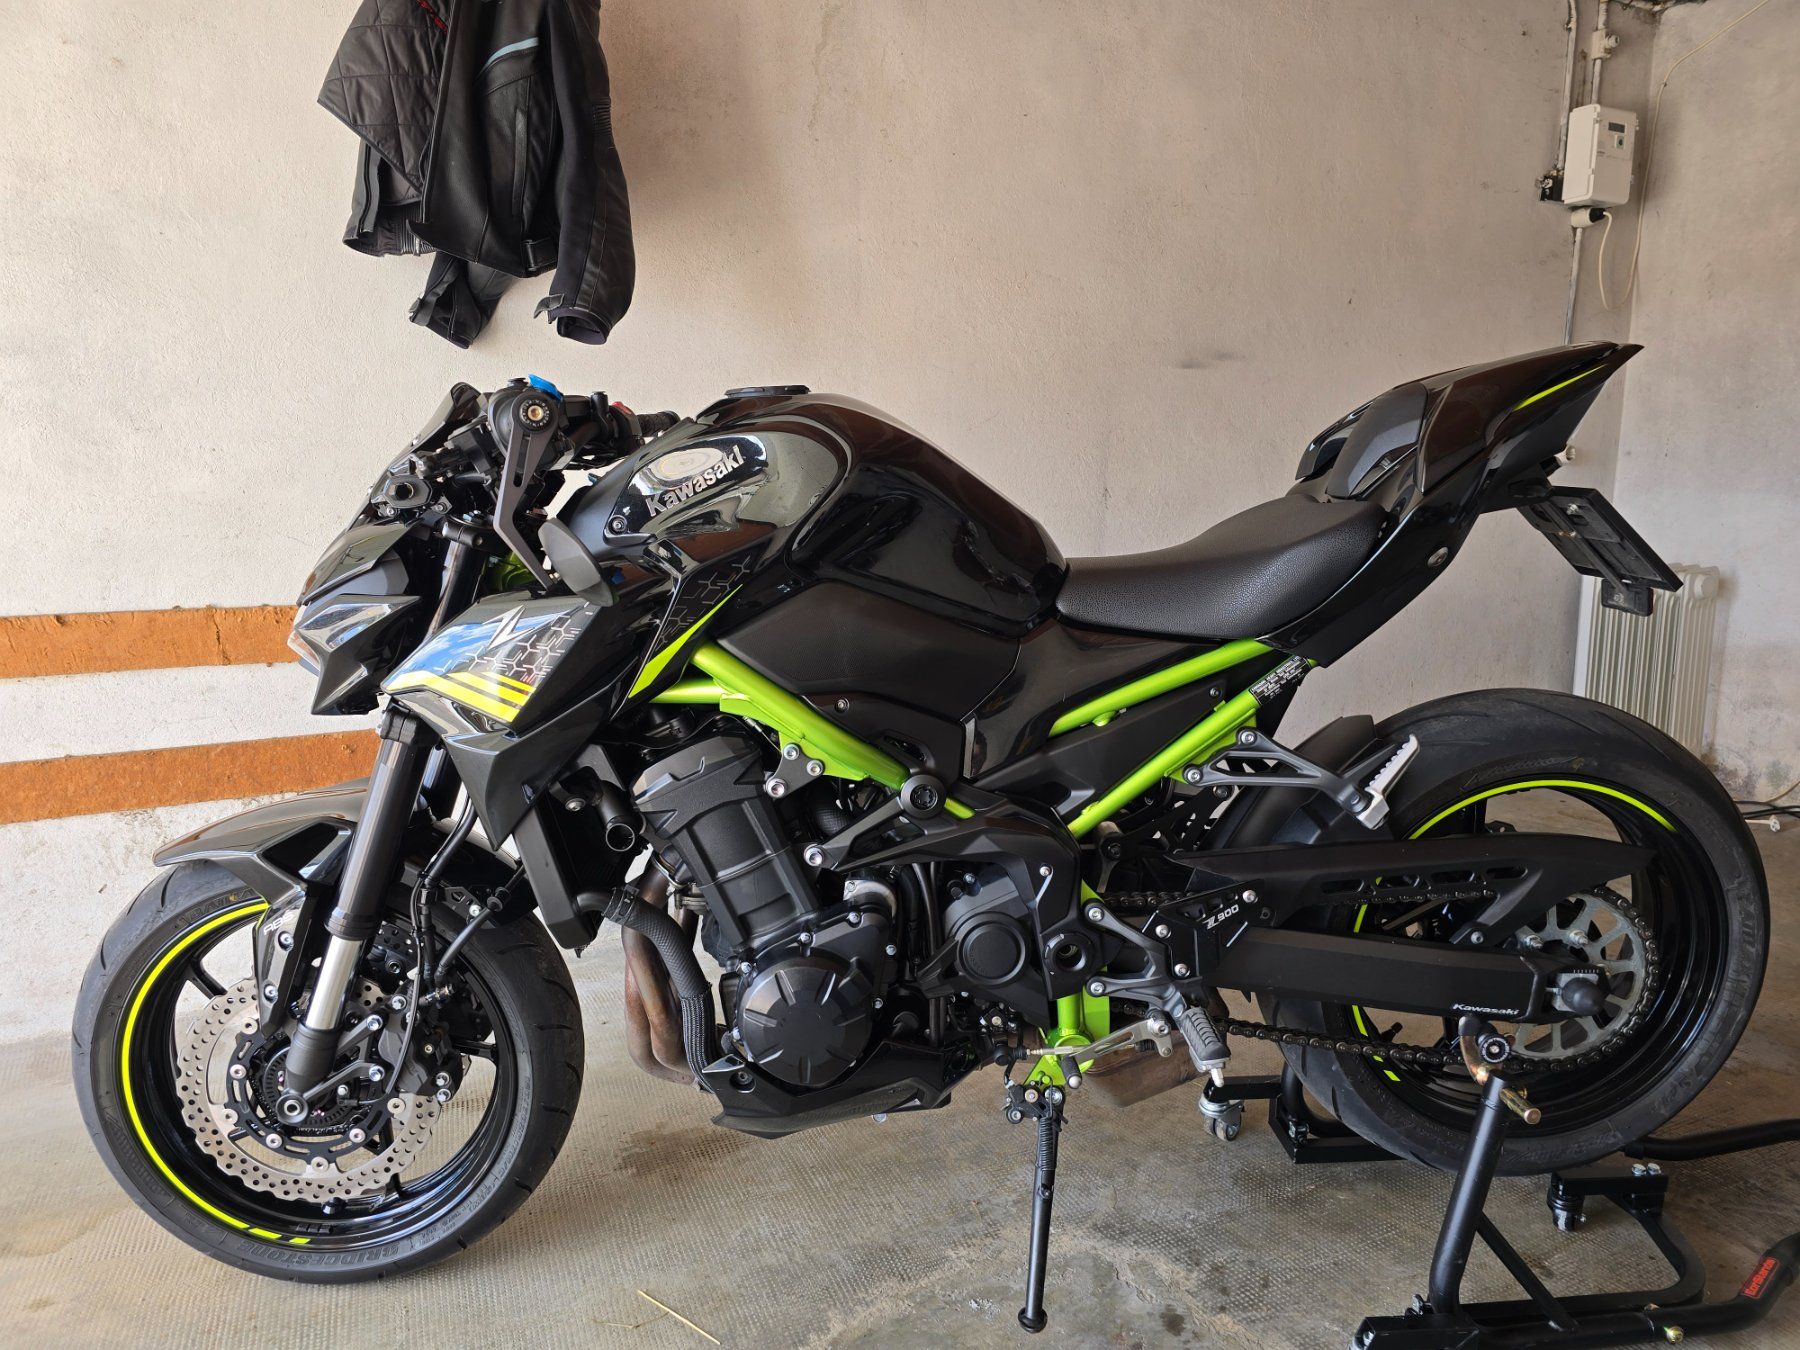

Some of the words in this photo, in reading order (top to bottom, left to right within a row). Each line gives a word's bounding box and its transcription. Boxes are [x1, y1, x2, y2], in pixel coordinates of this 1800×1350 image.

[645, 444, 745, 517] Kawasaki
[263, 909, 294, 936] ABS
[1452, 1003, 1519, 1015] Kawasaki
